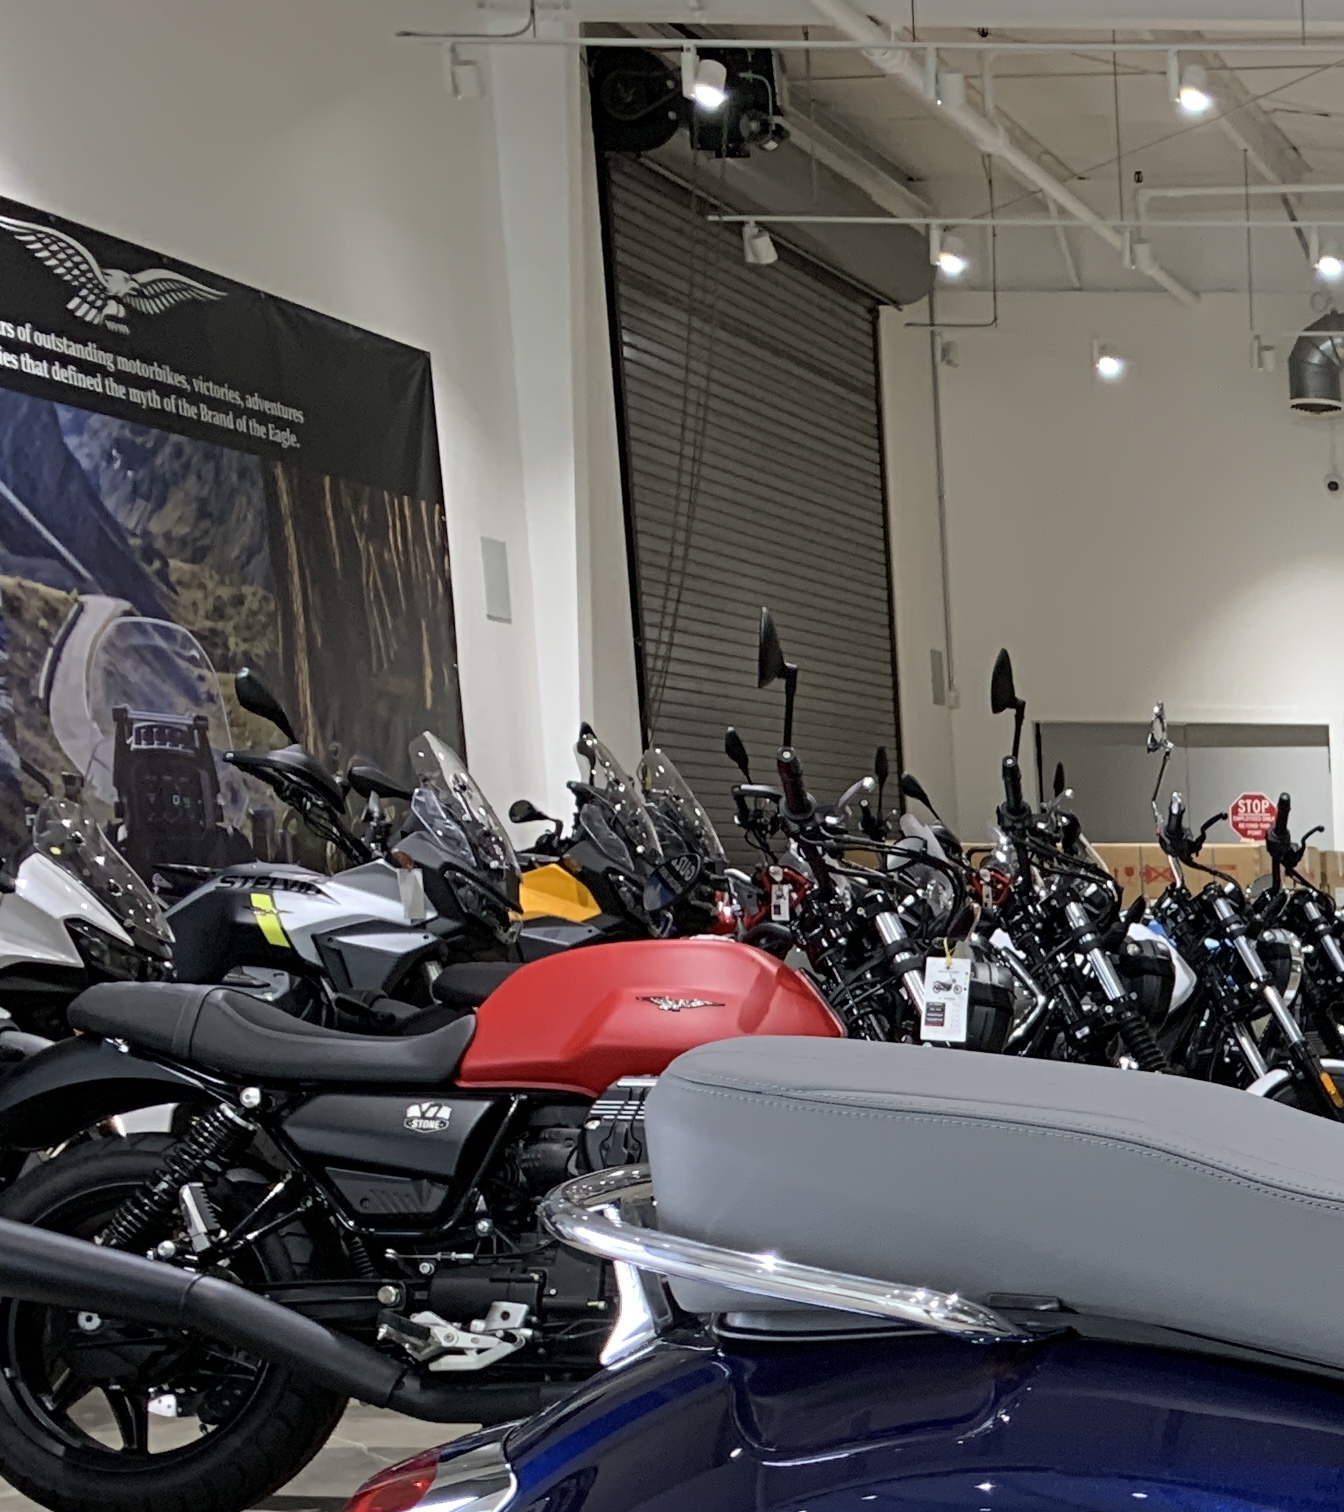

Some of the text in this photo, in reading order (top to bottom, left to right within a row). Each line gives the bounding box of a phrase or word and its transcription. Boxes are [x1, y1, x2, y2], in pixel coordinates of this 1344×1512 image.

[17, 323, 32, 344] of
[33, 332, 115, 372] outstanding
[116, 355, 191, 393] motorbikes,
[192, 375, 244, 409] victories,
[245, 393, 304, 424] adventures
[20, 353, 50, 378] that
[51, 361, 103, 394] defined
[105, 377, 127, 401] the
[128, 387, 161, 411] myth
[163, 394, 176, 413] of
[178, 397, 198, 420] the
[199, 403, 235, 430] Brand
[235, 415, 247, 433] of
[248, 418, 267, 439] the
[268, 423, 301, 449] Eagle.
[1237, 799, 1270, 813] STOP
[411, 1119, 440, 1129] STONE
